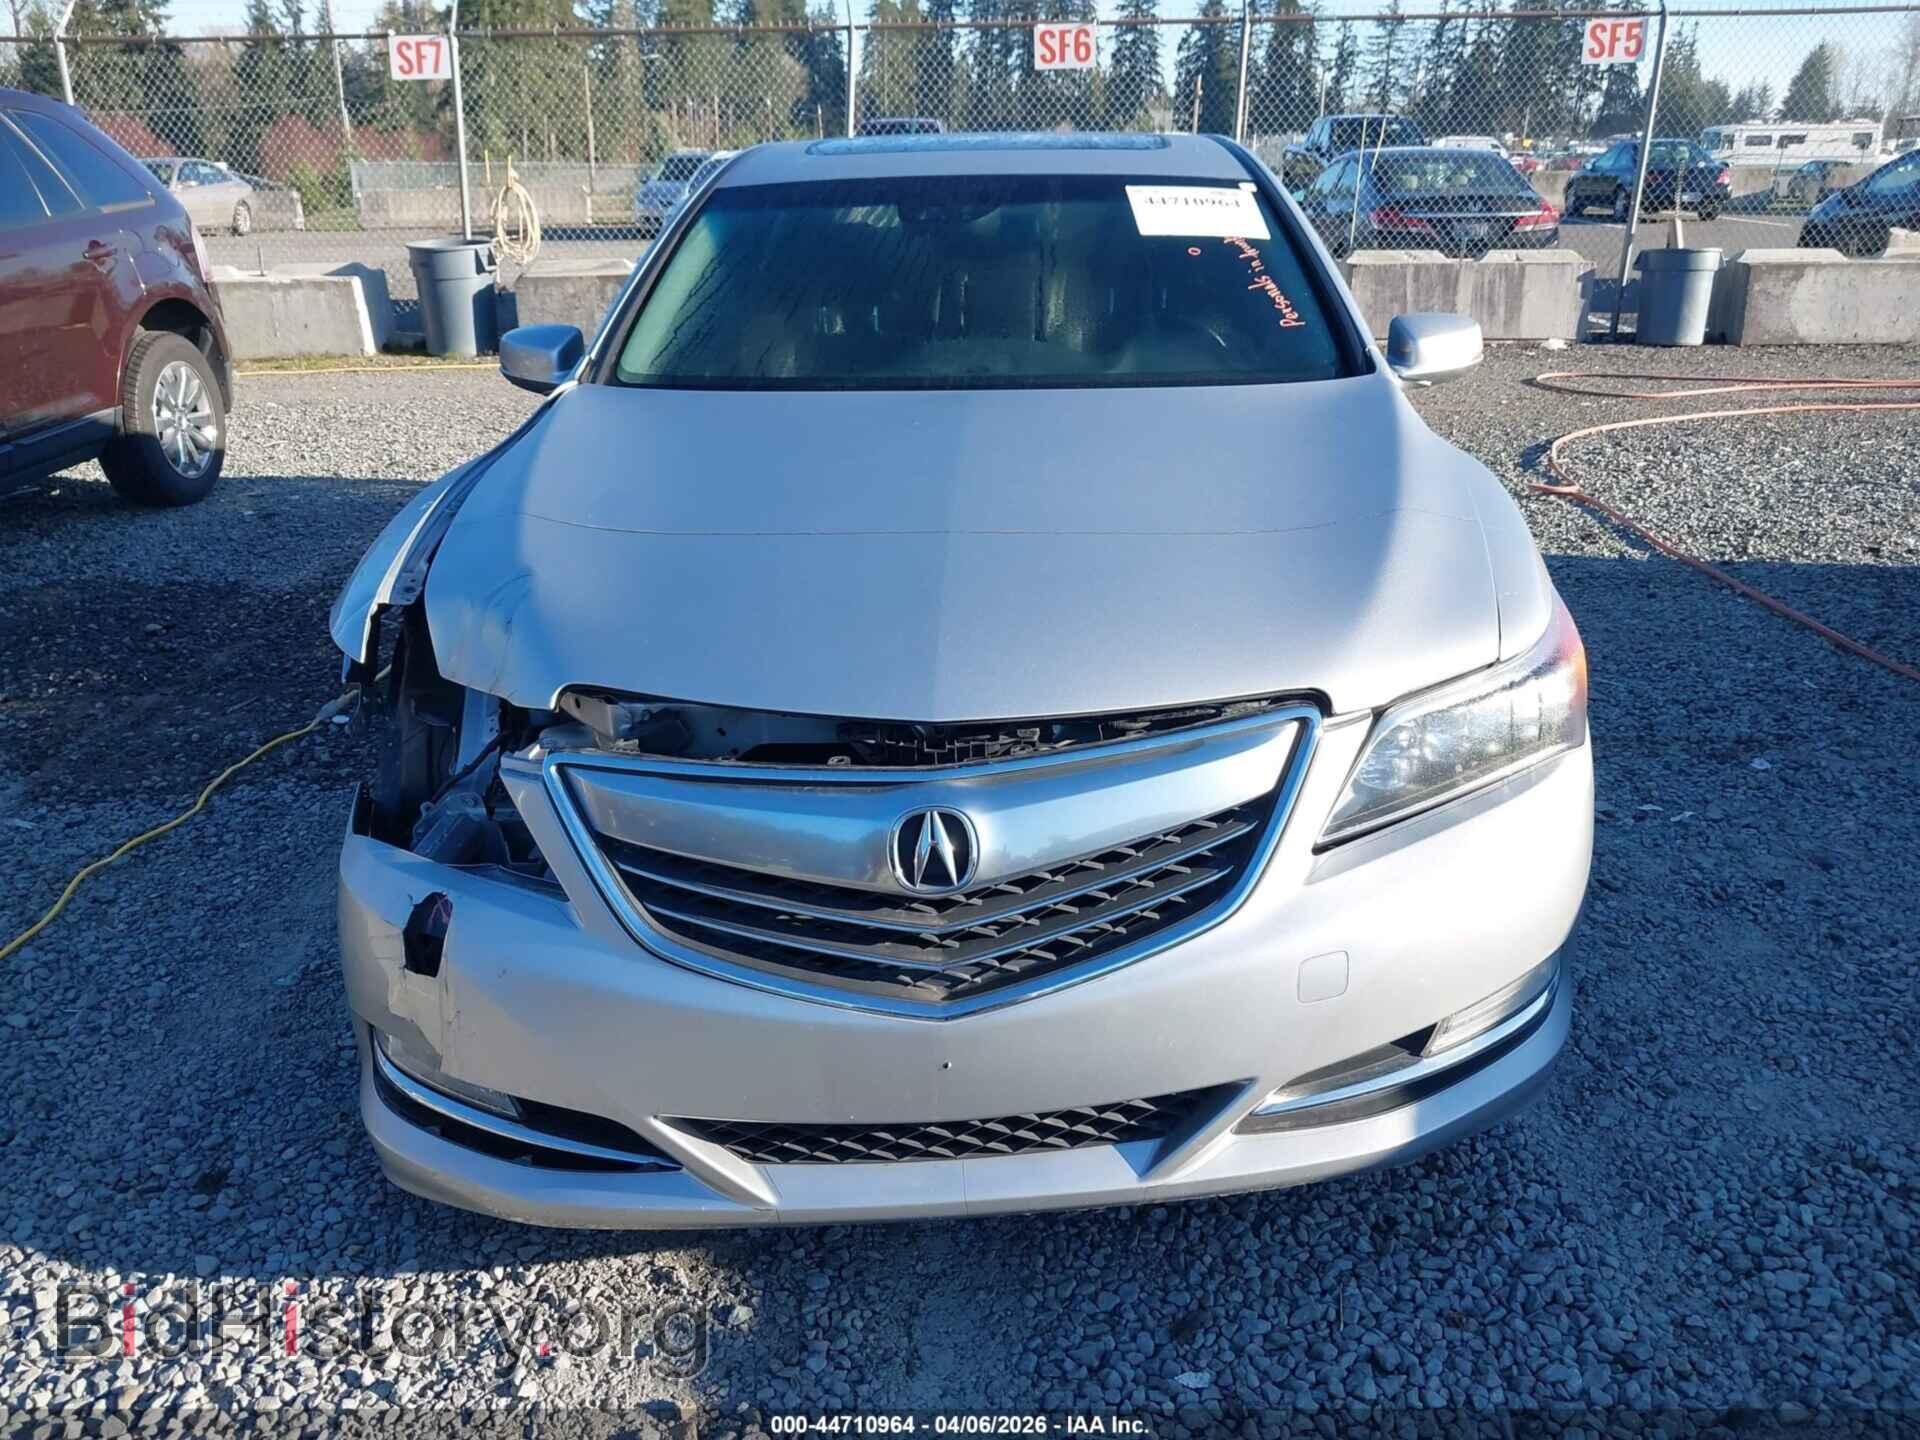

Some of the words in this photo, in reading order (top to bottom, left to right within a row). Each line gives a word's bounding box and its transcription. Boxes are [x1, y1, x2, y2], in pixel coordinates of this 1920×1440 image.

[396, 41, 442, 75] SF7
[1039, 28, 1091, 64] SF6
[1588, 22, 1644, 58] SF5
